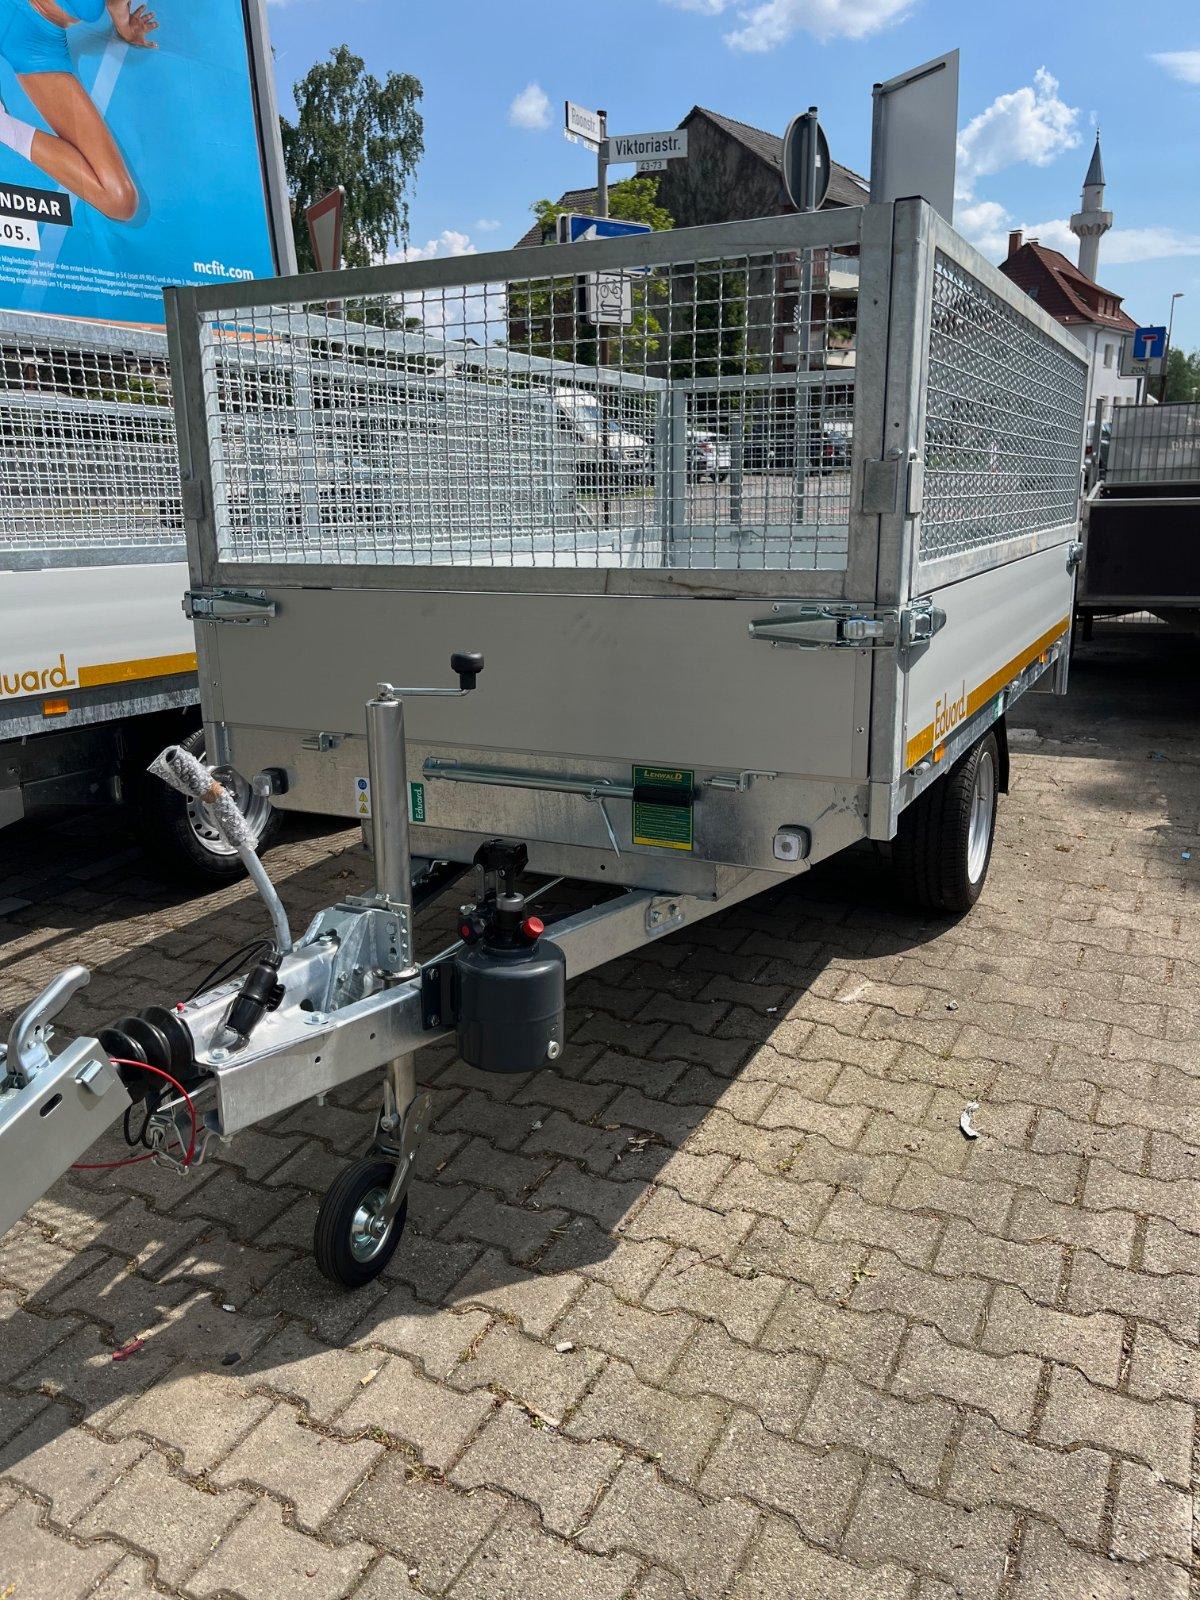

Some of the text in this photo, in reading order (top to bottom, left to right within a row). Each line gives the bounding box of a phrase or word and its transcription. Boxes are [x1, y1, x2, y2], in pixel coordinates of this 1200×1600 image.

[571, 107, 598, 134] Roonstr.
[615, 136, 681, 156] Viktoriastr.
[640, 161, 662, 171] 43-73
[193, 260, 254, 280] mcfit.com
[0, 653, 76, 696] uard
[933, 680, 966, 738] Eduard
[413, 787, 424, 819] Eduard
